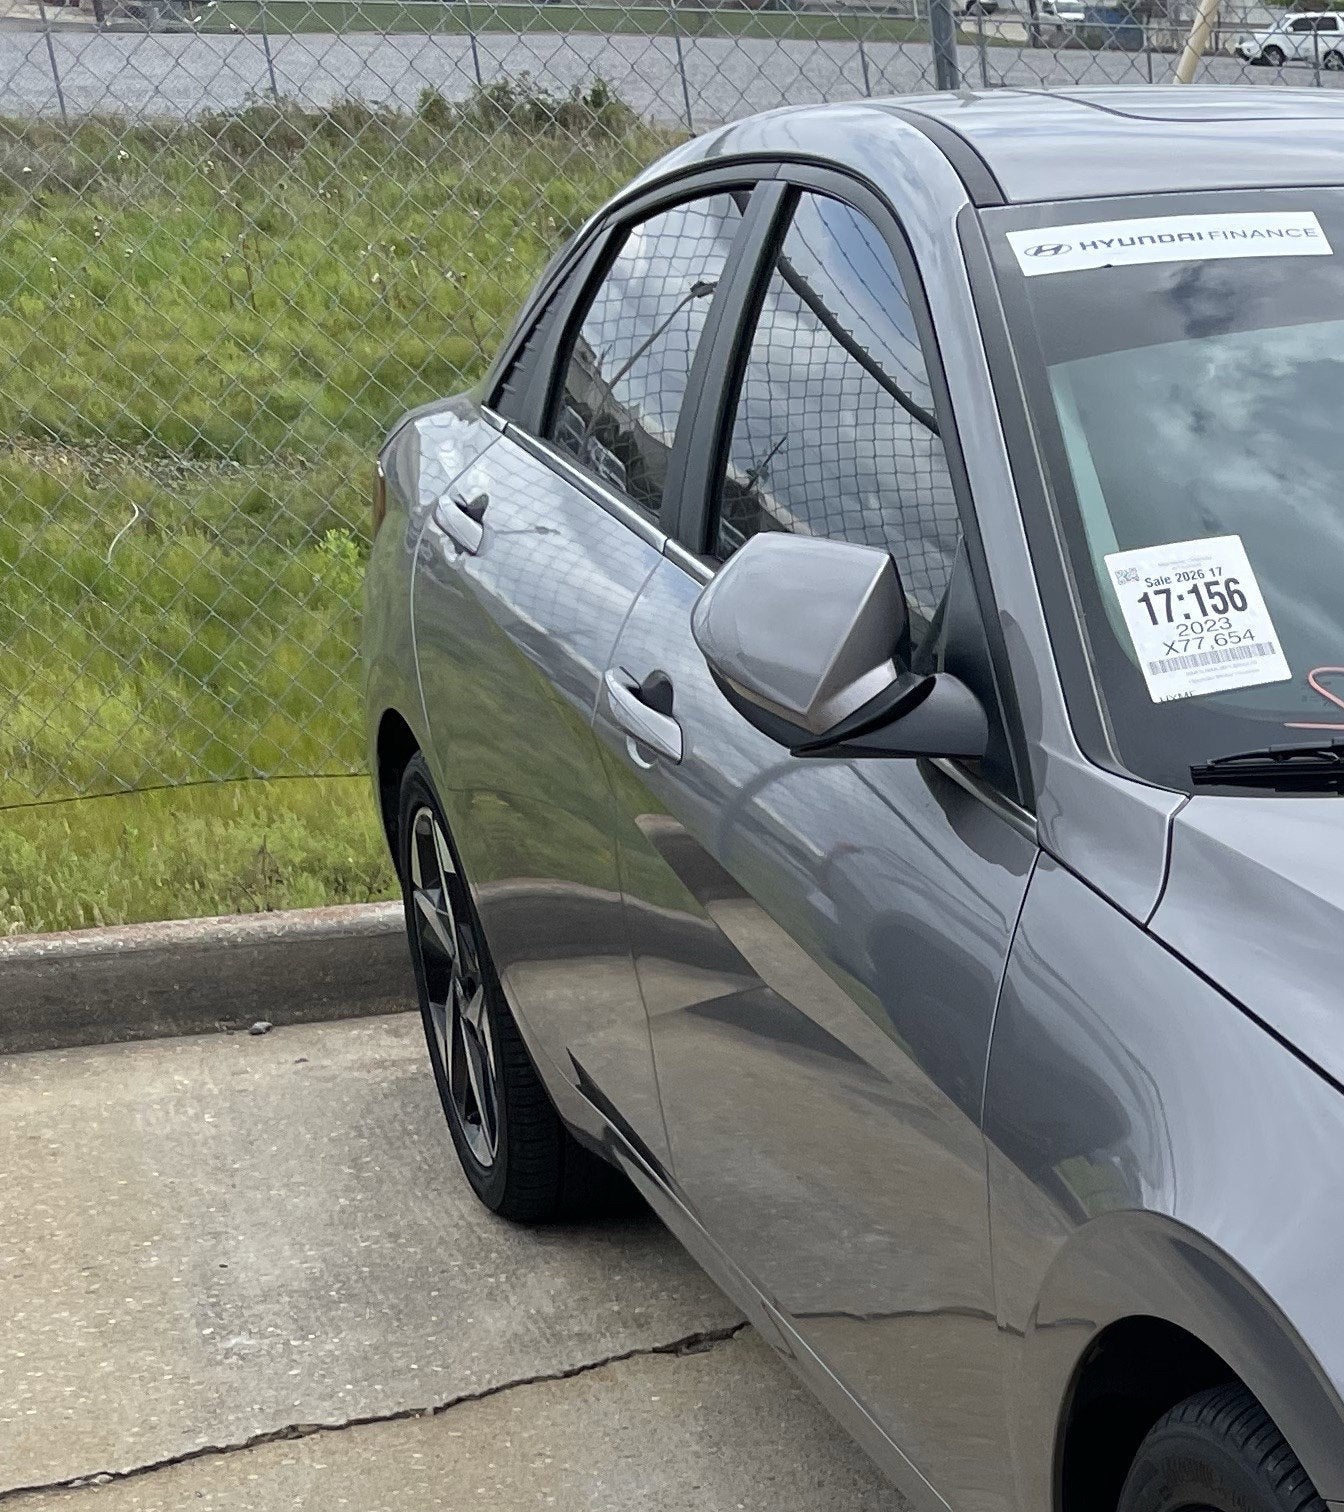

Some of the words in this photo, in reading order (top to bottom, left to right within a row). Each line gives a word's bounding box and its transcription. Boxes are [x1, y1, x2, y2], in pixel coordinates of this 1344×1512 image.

[1079, 231, 1204, 252] HYUNDAI
[1208, 226, 1320, 241] FINANCE
[1144, 573, 1172, 589] Sale
[1174, 569, 1206, 584] 2026
[1208, 566, 1223, 578] 17
[1137, 577, 1249, 626] 17:156
[1176, 616, 1233, 638] 2023
[1163, 628, 1257, 656] X77,654
